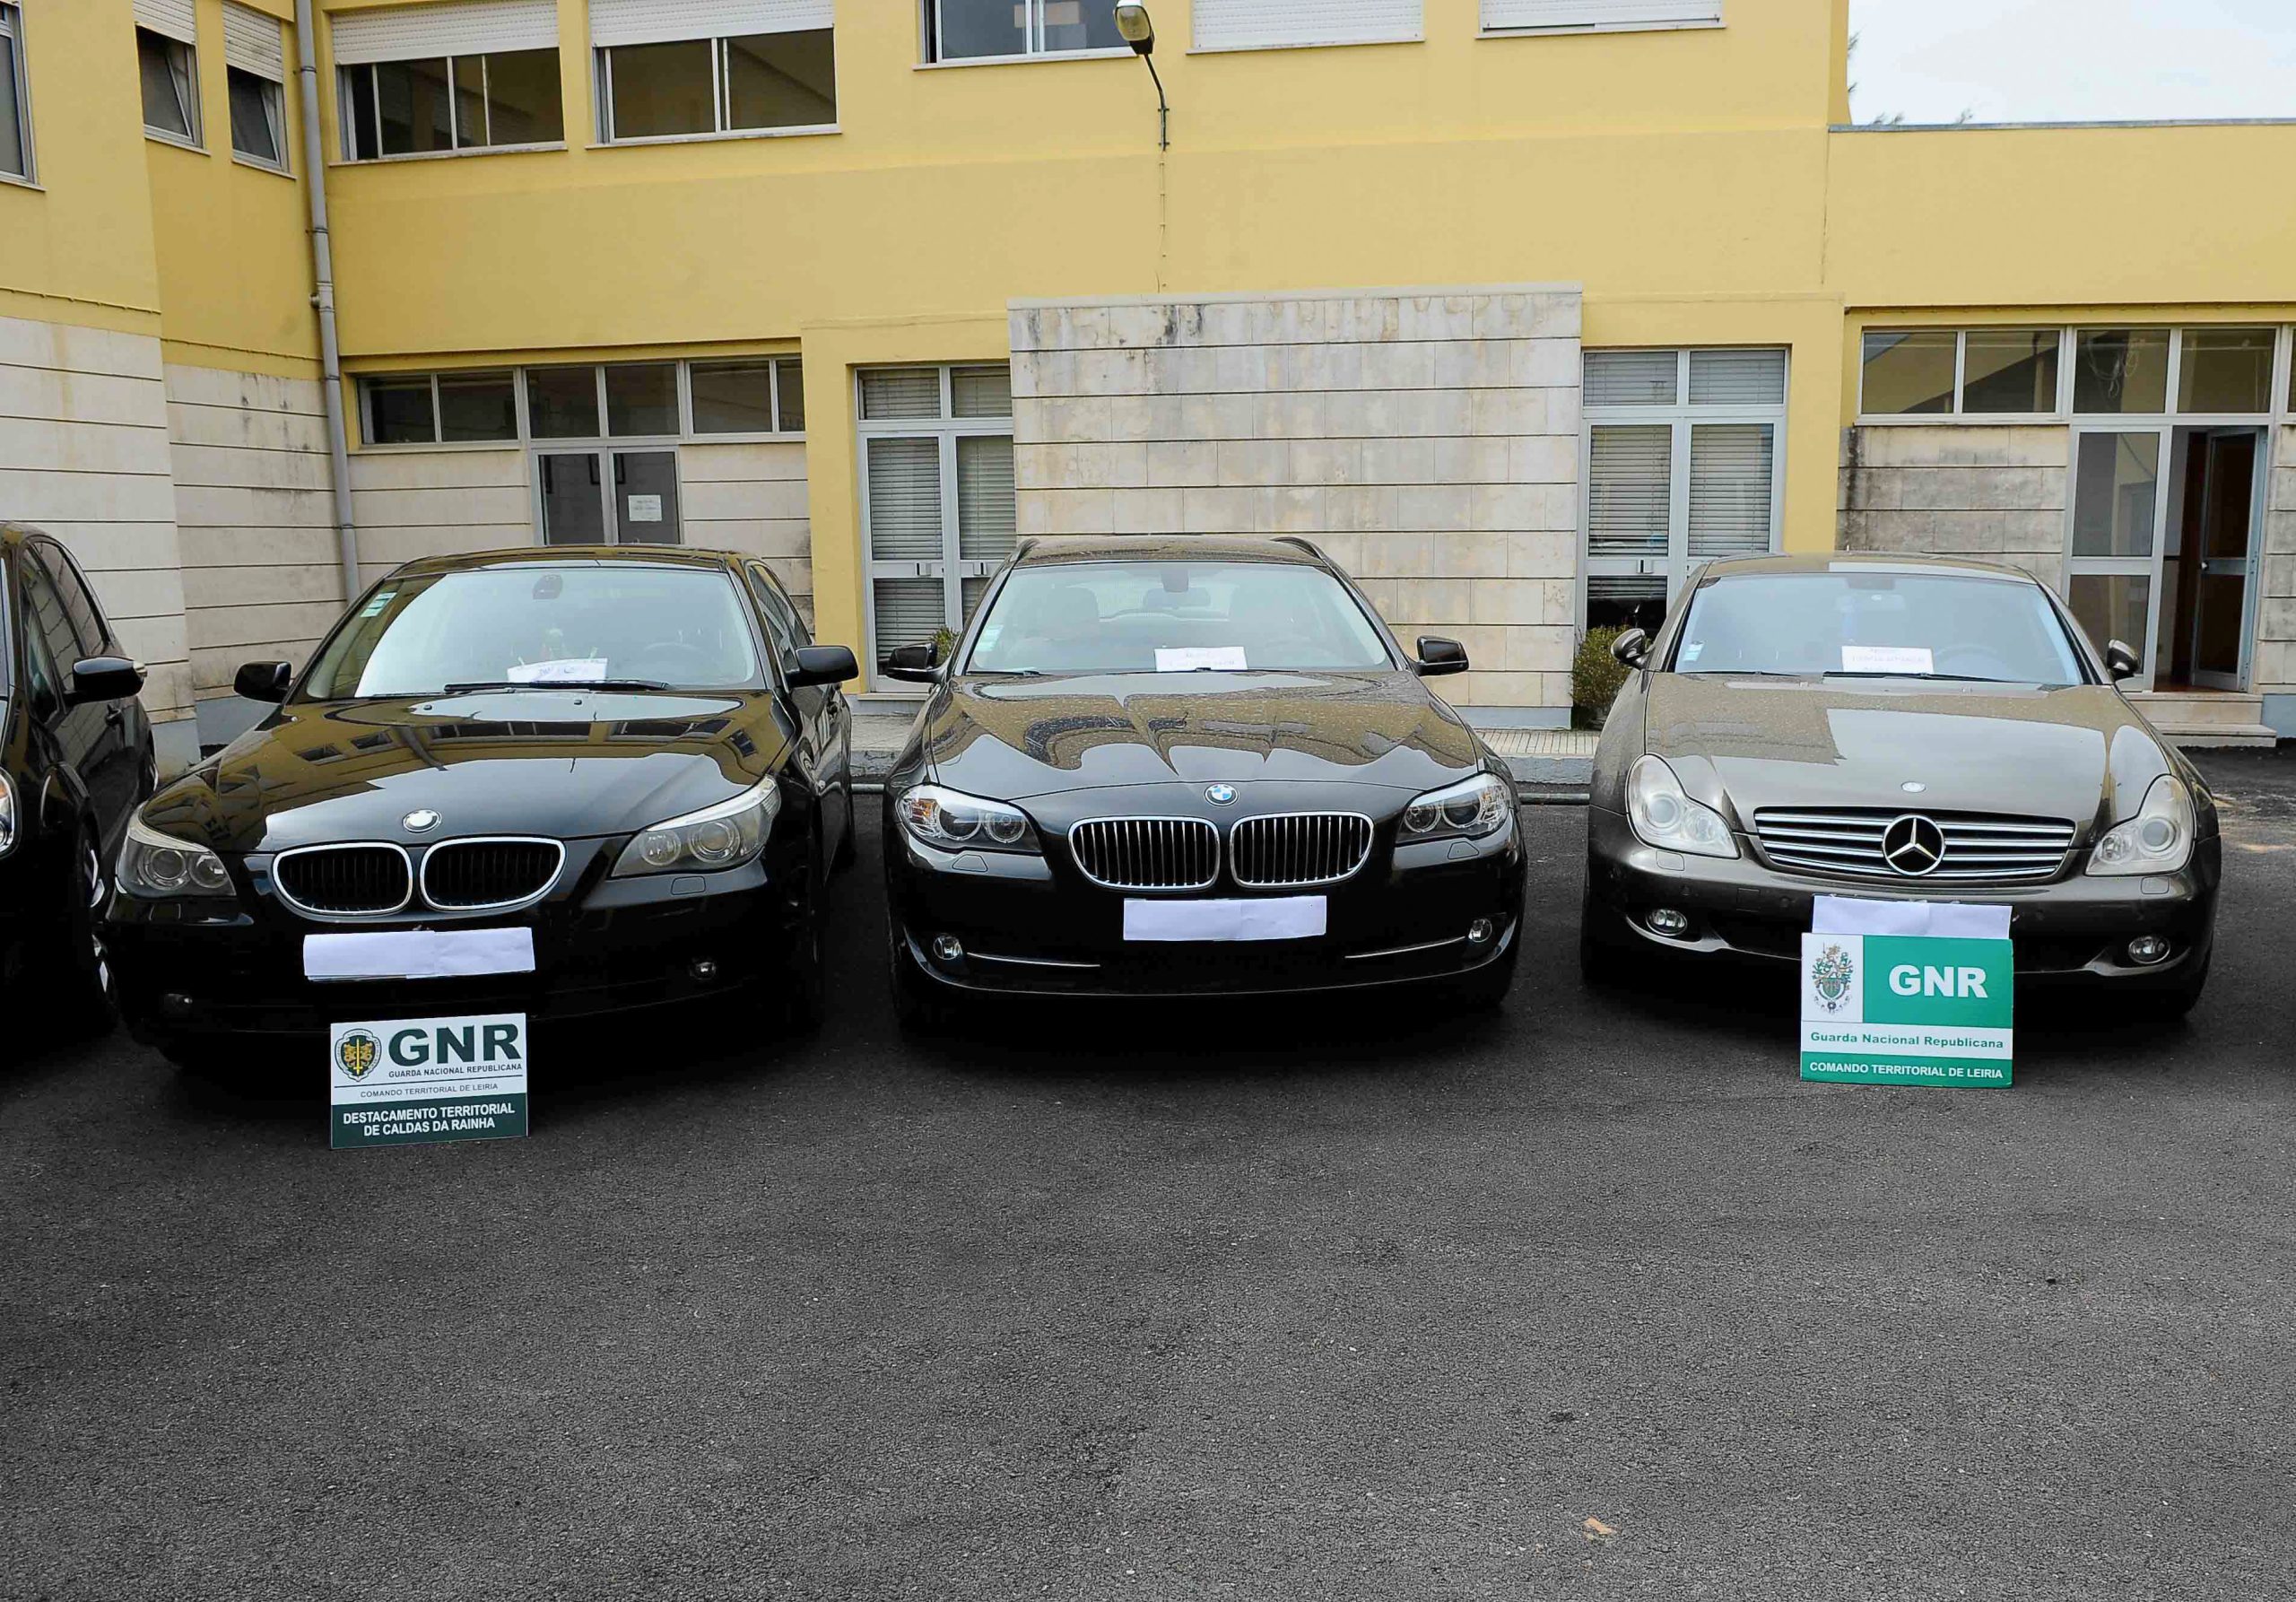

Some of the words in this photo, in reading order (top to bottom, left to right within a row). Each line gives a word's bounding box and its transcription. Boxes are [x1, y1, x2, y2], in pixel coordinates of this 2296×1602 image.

[1889, 964, 1988, 998] GNR
[388, 1023, 522, 1067] GNR
[1811, 1032, 1857, 1042] Guarda
[1863, 1033, 1919, 1045] Nacional
[1924, 1036, 2004, 1049] Republicana
[388, 1069, 422, 1078] GUARDA
[424, 1067, 465, 1076] NACIONAL
[466, 1063, 522, 1074] REPUBLICANA
[1810, 1062, 1869, 1074] COMANDO
[1872, 1064, 1946, 1077] TERRITORIAL
[1949, 1067, 1964, 1077] DE
[1967, 1068, 2004, 1079] LEIRIA
[361, 1089, 403, 1098] COMANDO
[405, 1086, 457, 1095] TERRITORIAL
[473, 1083, 499, 1092] LEIRIA
[344, 1108, 438, 1125] DESTACAMENTO
[439, 1102, 516, 1119] TERRITORIAL
[364, 1125, 380, 1136] DE
[382, 1121, 430, 1136] CALDAS
[432, 1119, 449, 1132] DA
[451, 1117, 496, 1130] RAINHA
